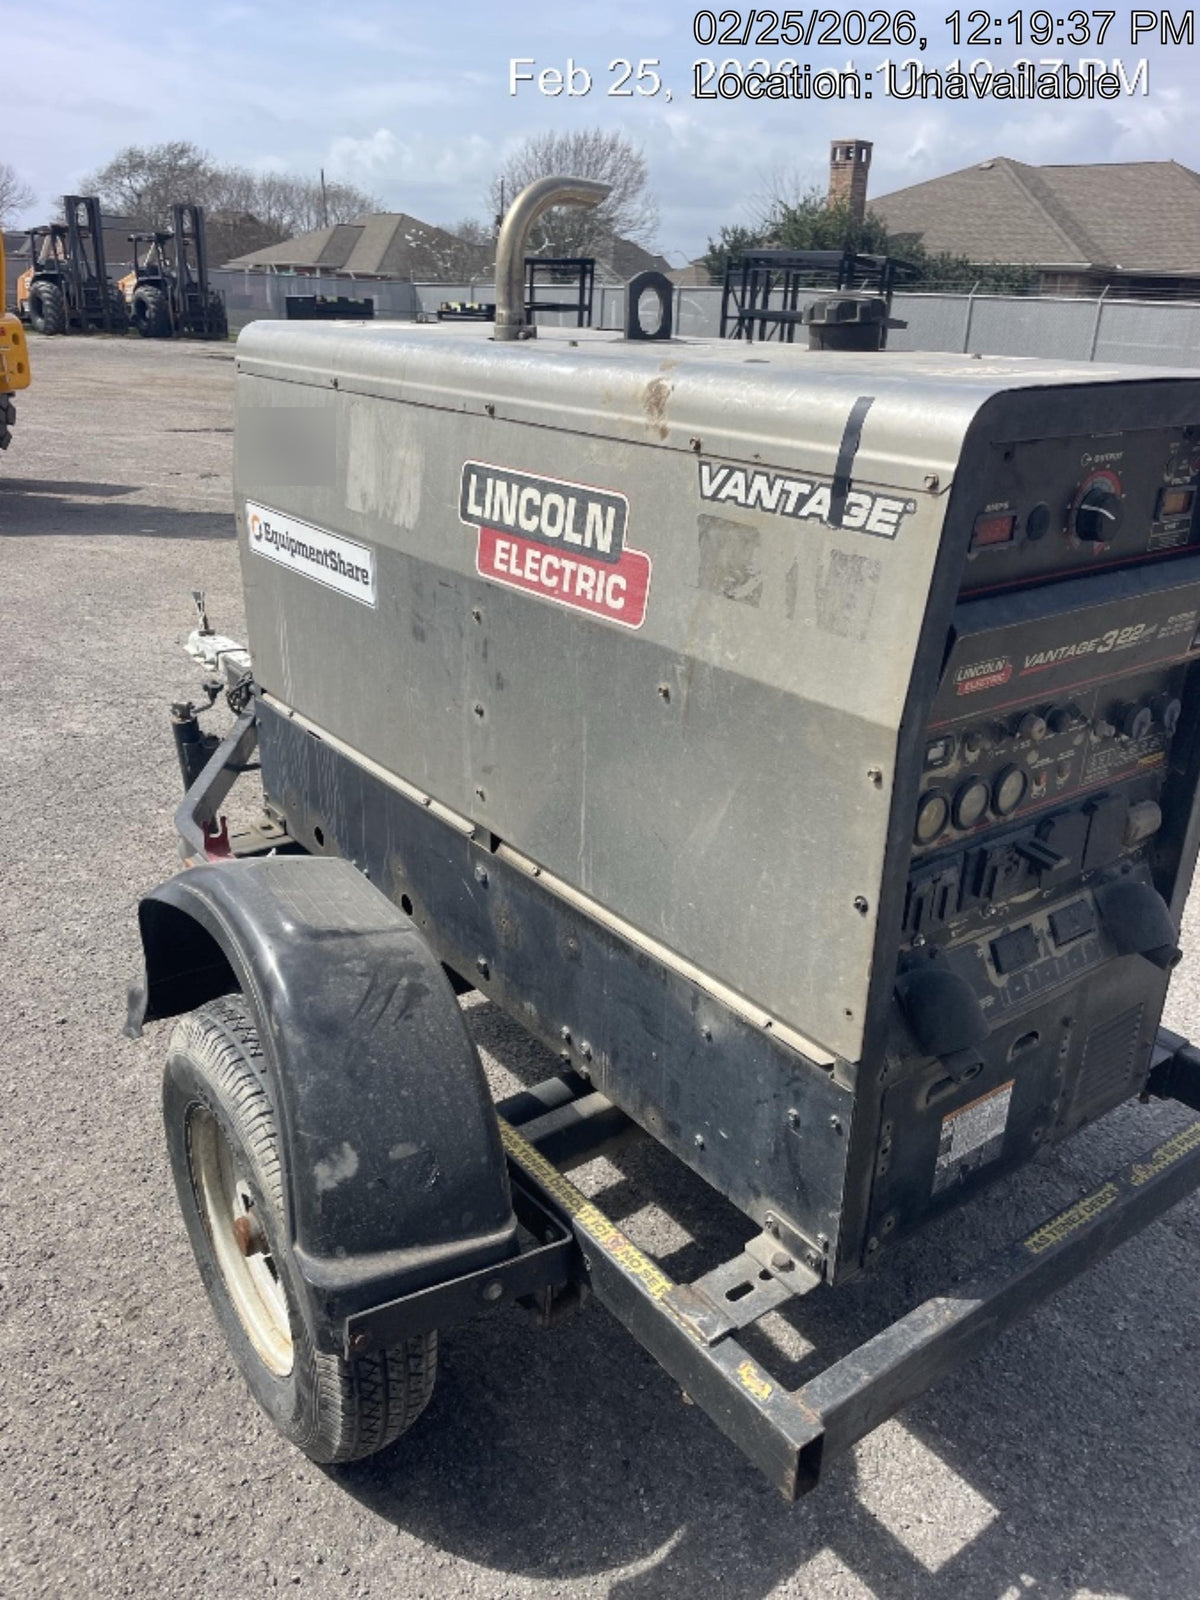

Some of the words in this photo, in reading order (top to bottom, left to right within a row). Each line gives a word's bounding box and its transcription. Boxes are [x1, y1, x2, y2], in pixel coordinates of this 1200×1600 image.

[467, 473, 616, 554] LINCOLN
[262, 520, 370, 587] EquipmentShare
[493, 540, 627, 609] ELECTRIC
[956, 658, 1006, 682] LINCOLN
[1023, 638, 1100, 668] VANTAGE
